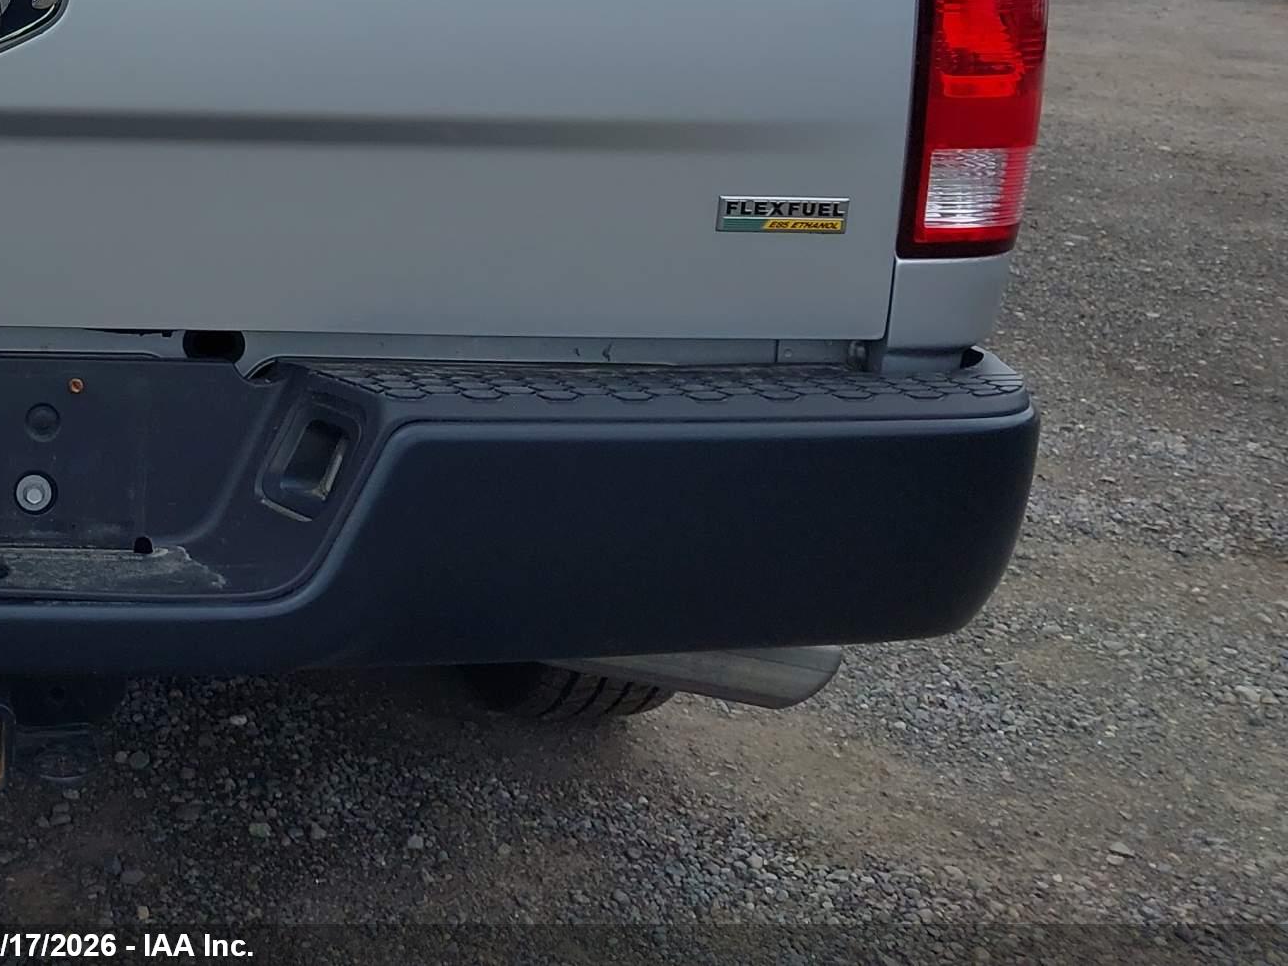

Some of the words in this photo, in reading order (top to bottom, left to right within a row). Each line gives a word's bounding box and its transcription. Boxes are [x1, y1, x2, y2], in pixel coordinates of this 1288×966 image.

[726, 201, 845, 217] FLEXFUEL
[768, 221, 790, 229] E85
[791, 221, 839, 229] ETHANOL
